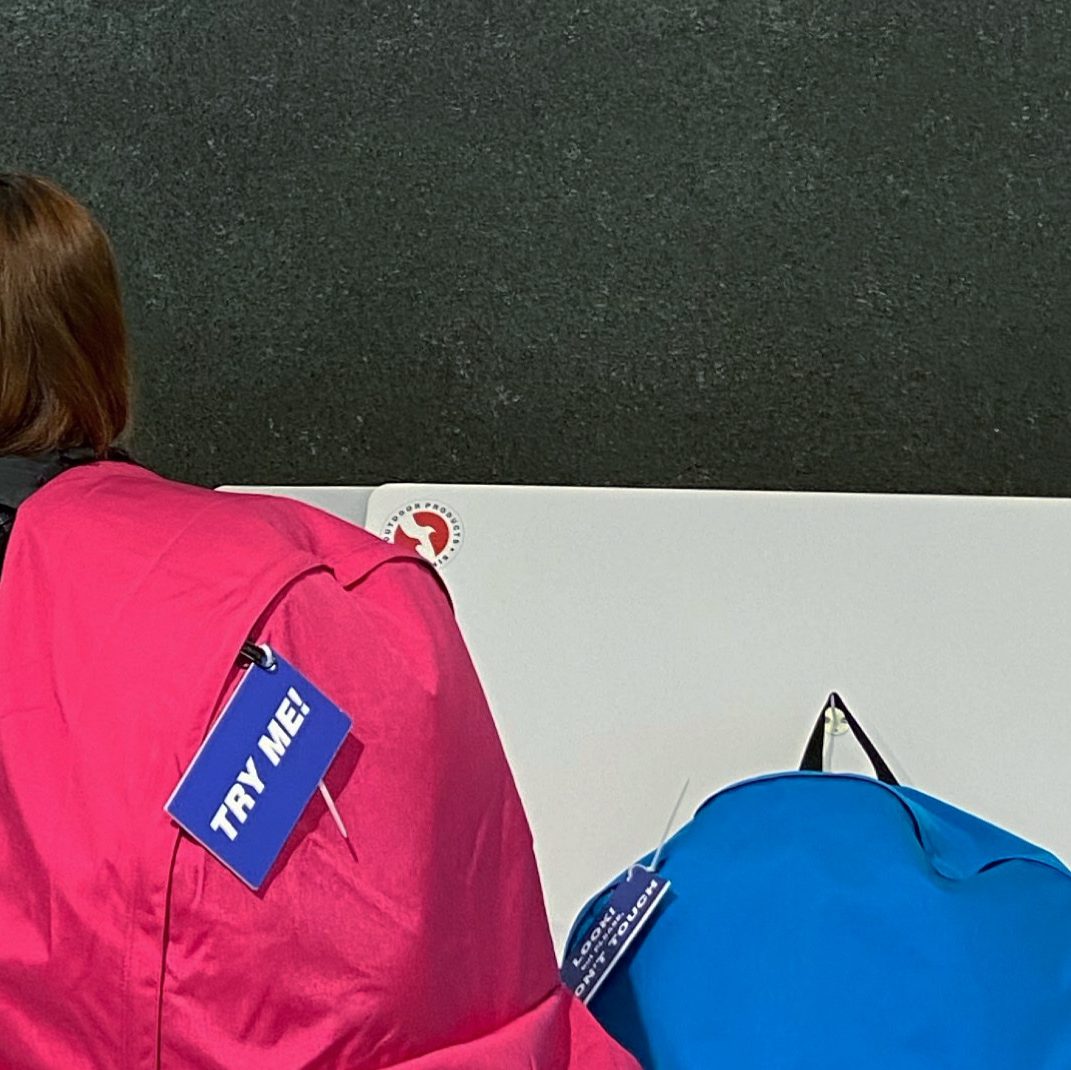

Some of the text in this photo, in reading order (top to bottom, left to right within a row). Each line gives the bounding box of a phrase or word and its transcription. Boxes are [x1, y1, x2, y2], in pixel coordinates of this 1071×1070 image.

[209, 686, 310, 841] TRY ME!
[573, 907, 617, 967] LOOK!
[574, 879, 658, 996] ON'T TOUCH
